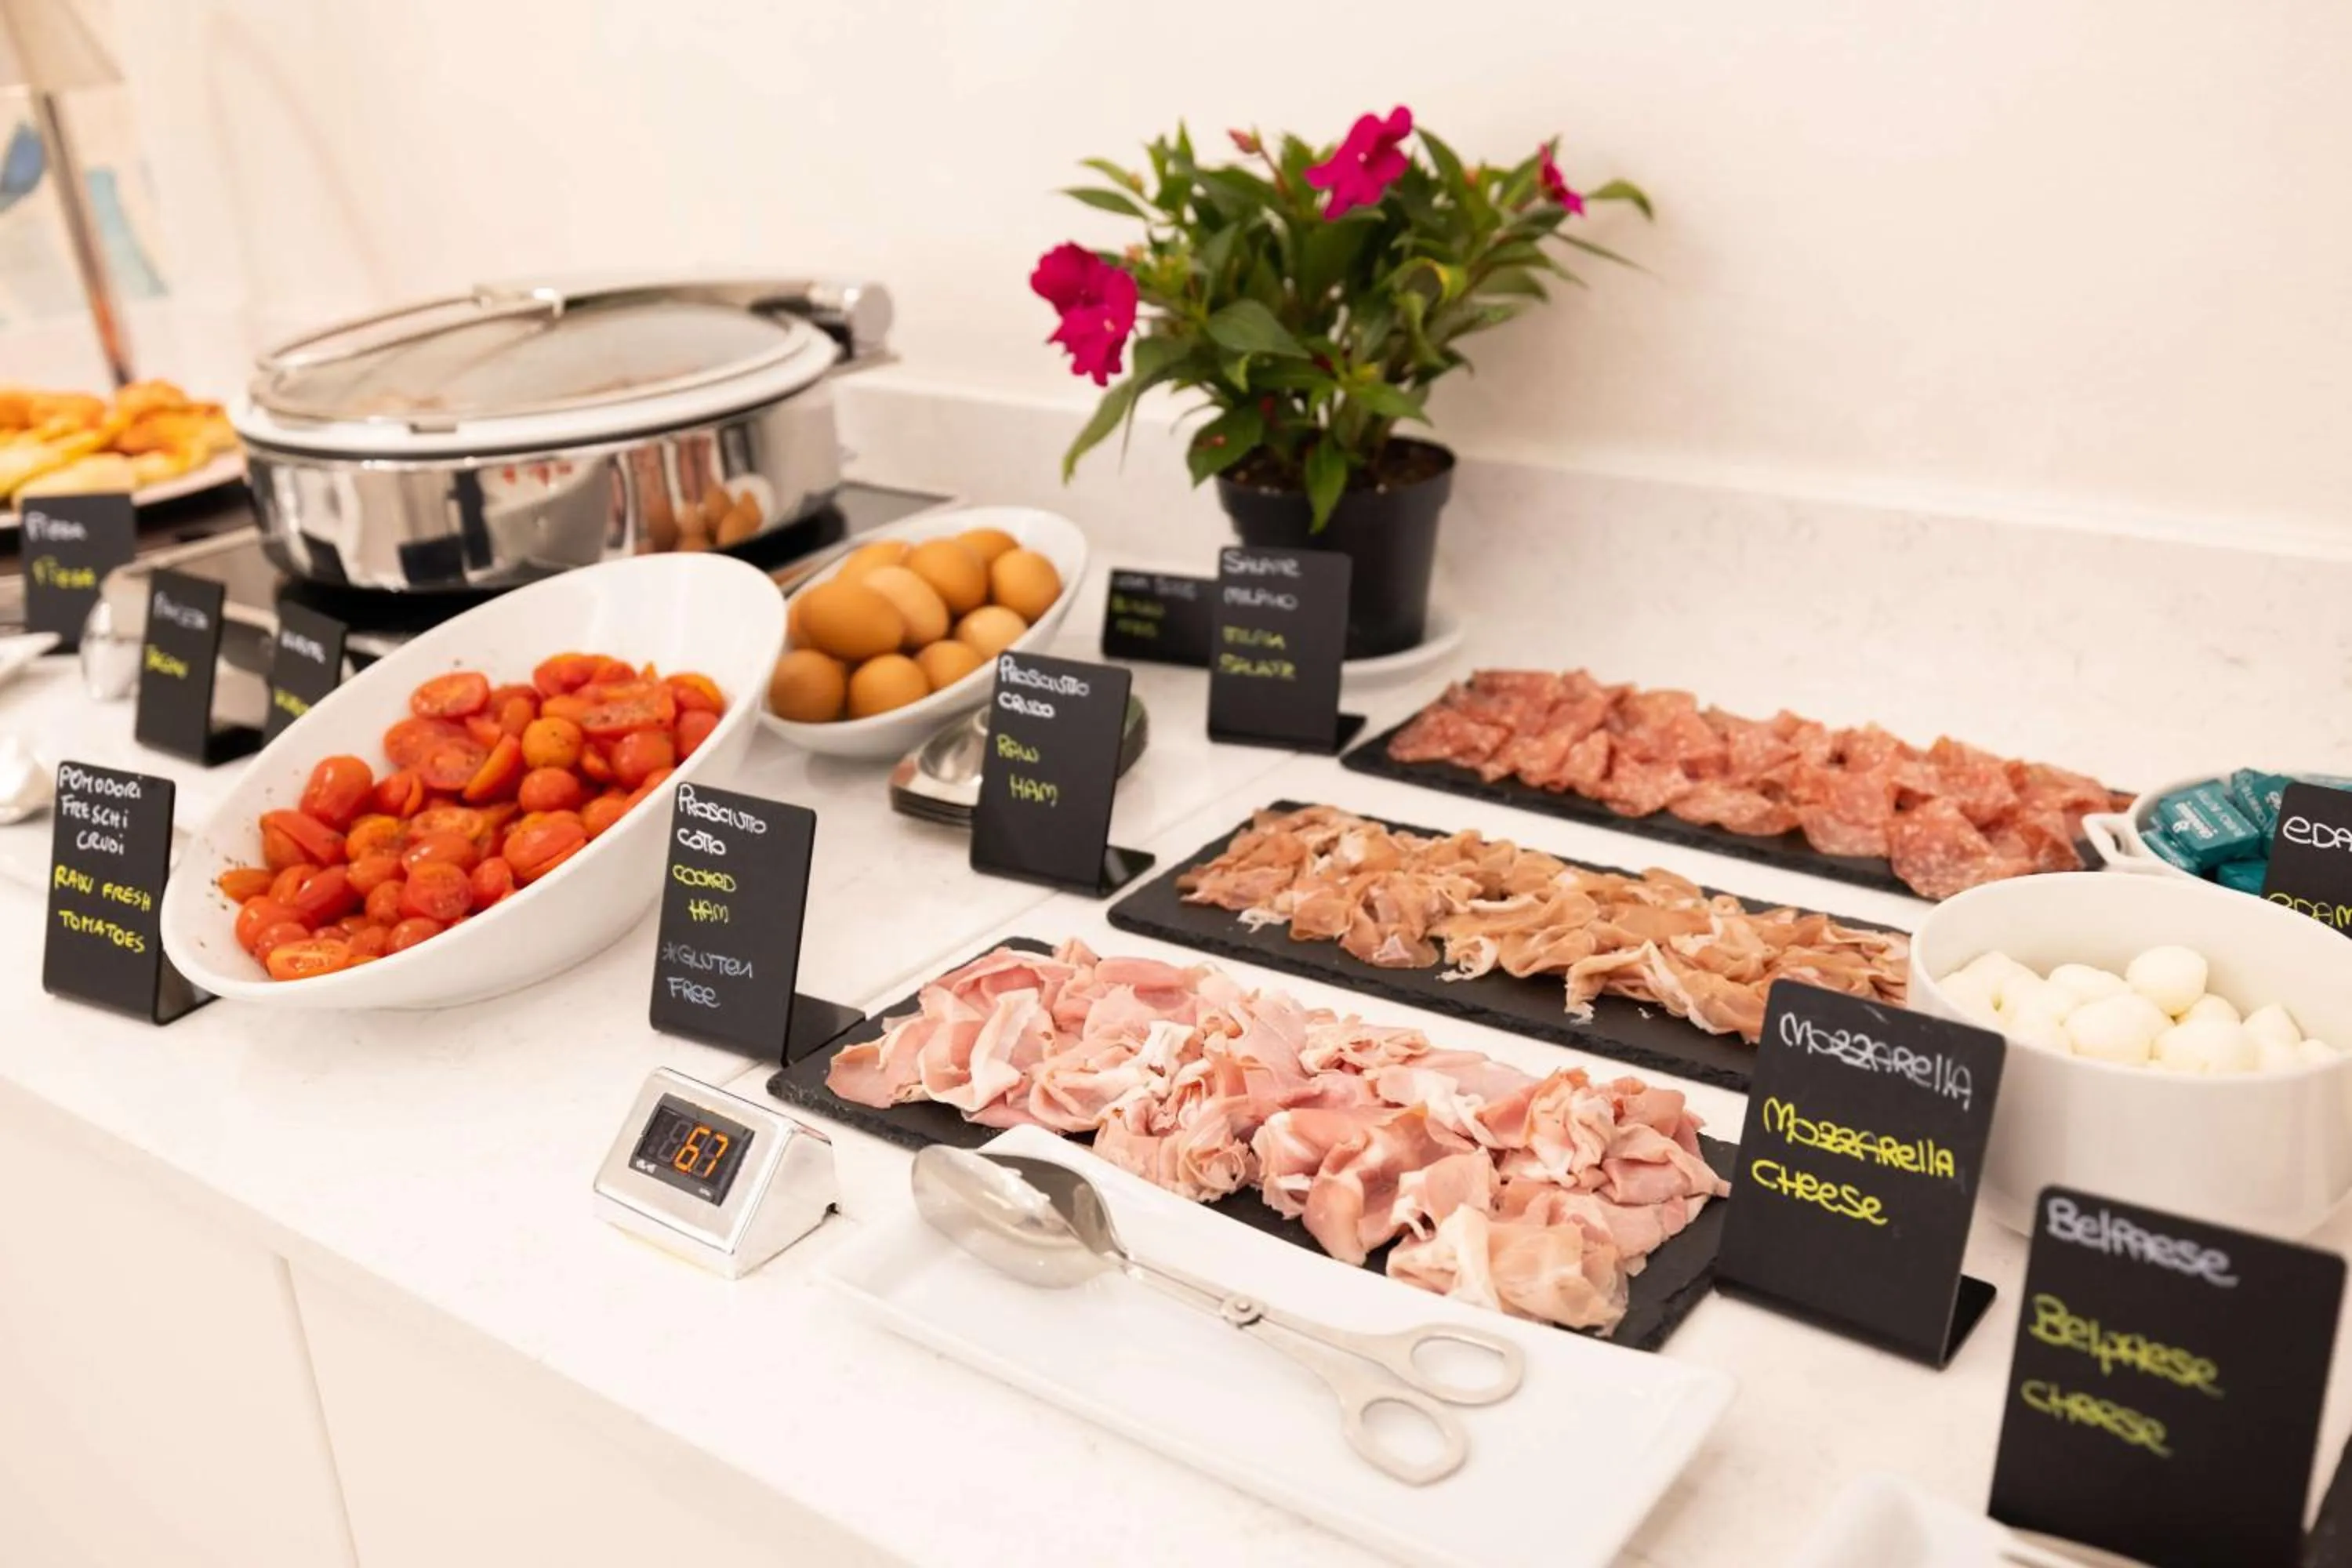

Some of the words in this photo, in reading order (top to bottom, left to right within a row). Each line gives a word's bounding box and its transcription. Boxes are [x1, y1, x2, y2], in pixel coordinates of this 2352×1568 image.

[998, 691, 1055, 717] CRUDO
[996, 734, 1040, 763] RAW
[679, 784, 767, 833] PROSCIUTTO
[1010, 773, 1058, 808] HAM
[54, 865, 94, 895] RAW
[102, 884, 151, 912] FRESH
[59, 909, 146, 953] TOMATOES
[688, 899, 728, 924] HAM
[667, 977, 720, 1007] FRee
[673, 1123, 729, 1178] 67
[1751, 1160, 1887, 1225] CHeeSe
